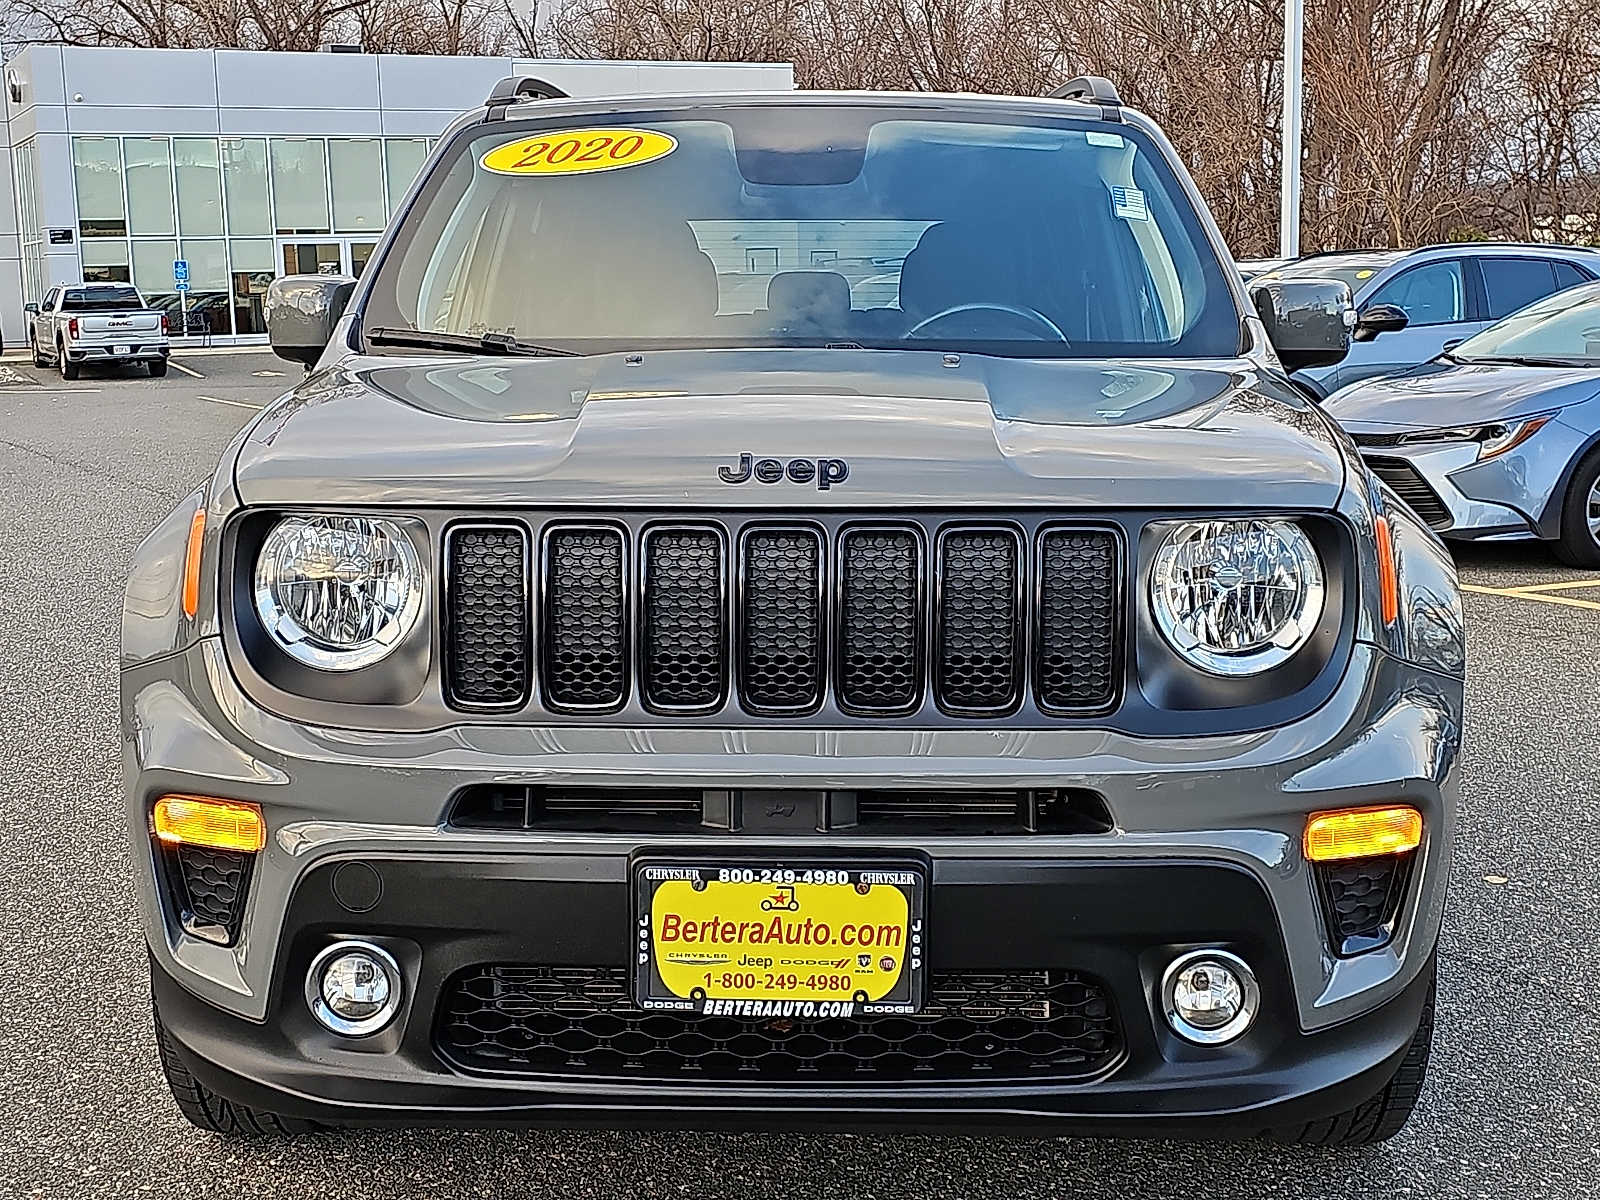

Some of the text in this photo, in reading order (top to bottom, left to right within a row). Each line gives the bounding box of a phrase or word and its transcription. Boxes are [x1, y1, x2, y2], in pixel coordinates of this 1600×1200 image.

[511, 136, 643, 168] 2020
[718, 453, 849, 490] Jeep
[645, 869, 700, 880] CHRYSLER
[718, 869, 849, 885] 800-249-4980
[860, 873, 915, 885] CHRYSLER
[661, 914, 901, 947] BerteraAuto.com
[639, 915, 649, 965] Jeep
[912, 920, 922, 970] Jeep
[737, 954, 773, 969] Jeep
[703, 973, 851, 991] 1-800-249-4980
[643, 1001, 694, 1010] DODGE
[702, 1001, 854, 1018] BERTERAAUTO.COM
[863, 1005, 915, 1014] DODGE
